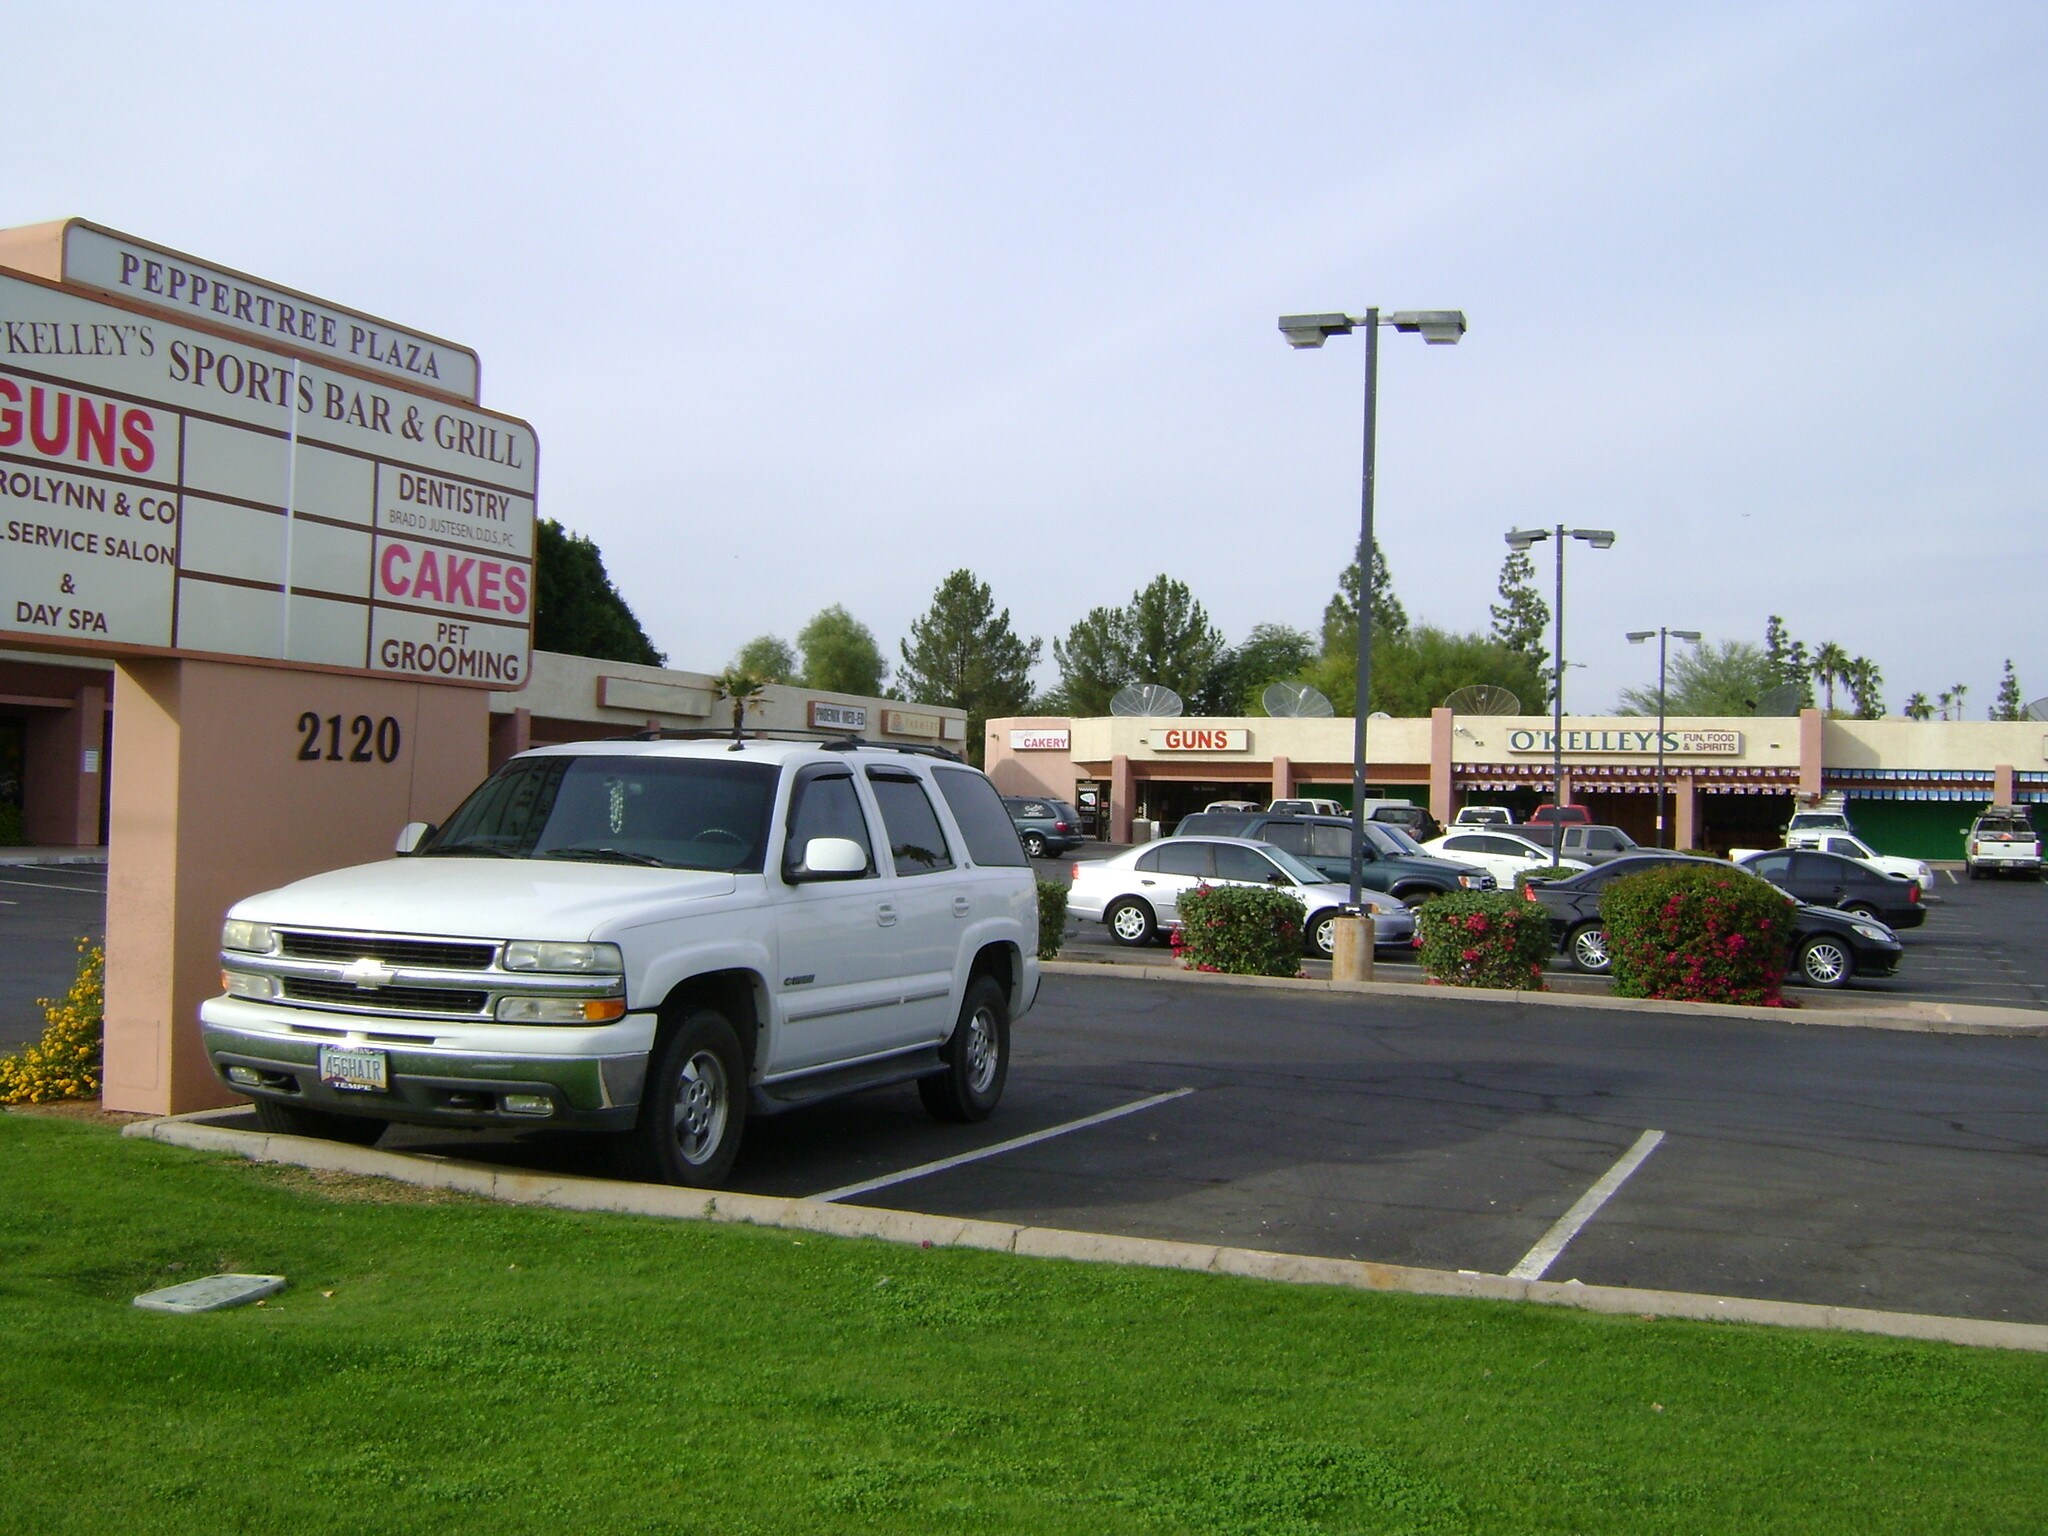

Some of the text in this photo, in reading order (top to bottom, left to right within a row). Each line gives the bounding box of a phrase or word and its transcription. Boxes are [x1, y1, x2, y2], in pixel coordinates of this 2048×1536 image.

[119, 251, 440, 380] PEPPERTREE PLAZA
[169, 340, 315, 414] SPORTS
[323, 382, 393, 434] BAR
[401, 405, 424, 443] &
[434, 414, 523, 470] GRILL
[114, 492, 130, 518] &
[139, 497, 176, 525] CO
[399, 472, 510, 522] DENTISTRY
[389, 509, 417, 527] BRAD
[419, 515, 427, 530] D
[8, 520, 175, 567] SERVICE SALON
[60, 573, 75, 595] &
[380, 543, 528, 615] CAKES
[16, 601, 108, 634] DAY SPA
[437, 622, 470, 646] PET
[381, 639, 519, 682] GROOMING
[298, 711, 401, 763] 2120
[1023, 738, 1067, 748] CAKERY
[1165, 730, 1228, 749] GUNS
[1510, 731, 1680, 751] O'KELLEY'S
[1683, 733, 1735, 743] FUN, FOOD
[1683, 742, 1736, 752] & SPIRITS
[325, 1054, 381, 1080] 456HAIR
[333, 1082, 372, 1091] TEMPE
